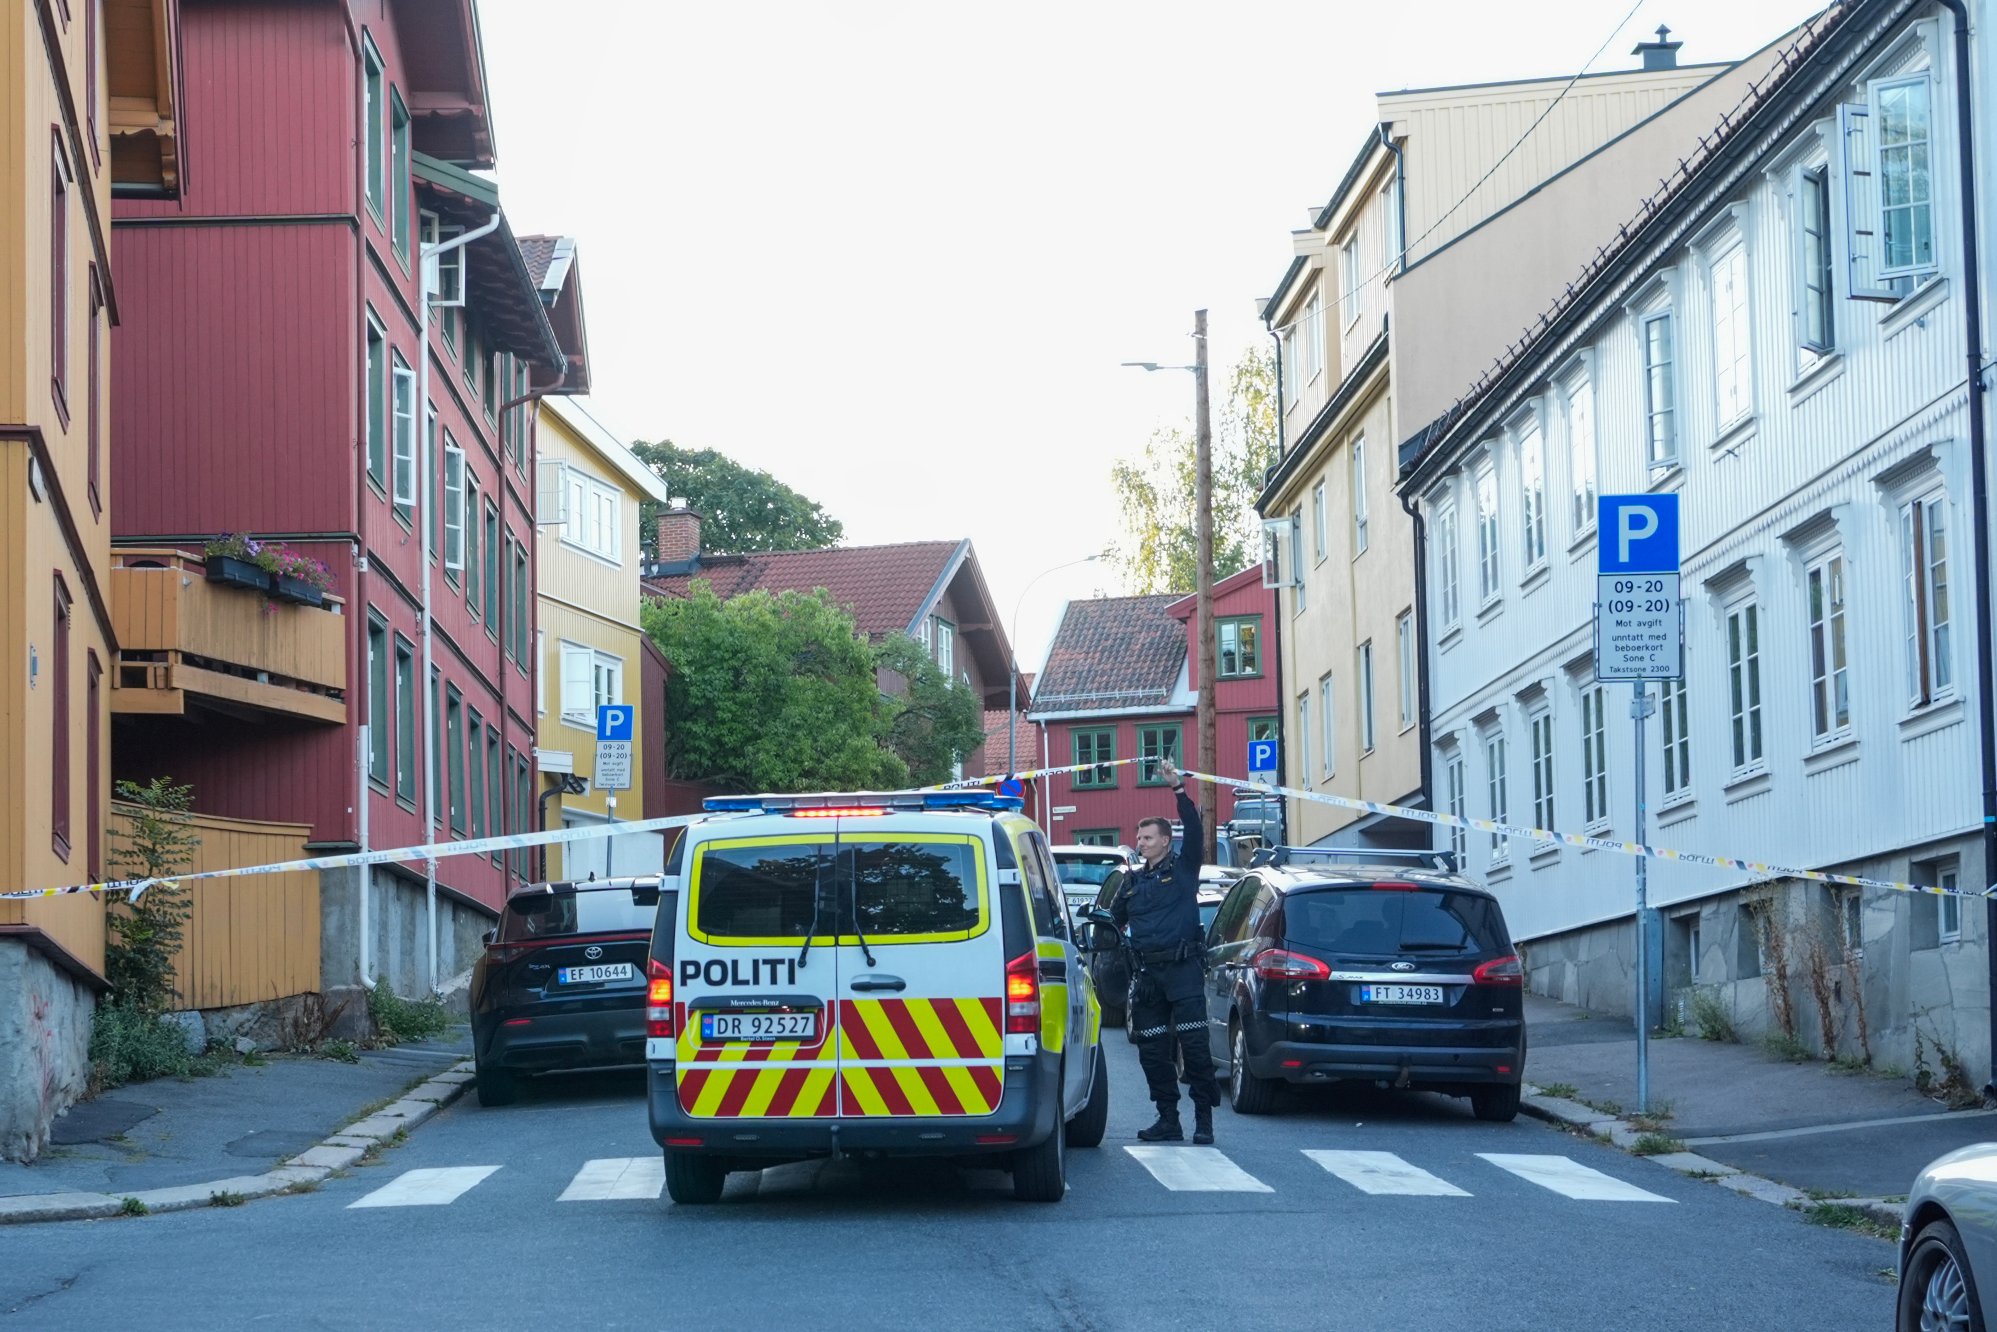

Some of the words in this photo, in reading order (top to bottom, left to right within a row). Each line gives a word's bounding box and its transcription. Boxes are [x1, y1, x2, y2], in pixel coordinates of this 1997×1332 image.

[1618, 505, 1659, 563] P
[1614, 580, 1663, 593] 09-20
[1608, 598, 1670, 614] (09-20)
[1615, 619, 1632, 628] Mot
[1636, 619, 1662, 629] avgift
[1611, 633, 1644, 642] unntatt
[1648, 633, 1667, 641] med
[1615, 643, 1663, 652] beboerkort
[1623, 654, 1645, 662] Sone
[1649, 654, 1656, 662] C
[1609, 666, 1647, 674] Takstsone
[606, 710, 624, 736] P
[1255, 744, 1271, 768] P
[570, 968, 585, 981] EF
[590, 965, 628, 980] 10644
[680, 959, 795, 986] POLITI
[1375, 987, 1391, 999] FT
[1398, 986, 1440, 1001] 34983
[730, 999, 780, 1007] Mercedes-Benz
[718, 1017, 742, 1035] DR
[752, 1016, 810, 1034] 92527
